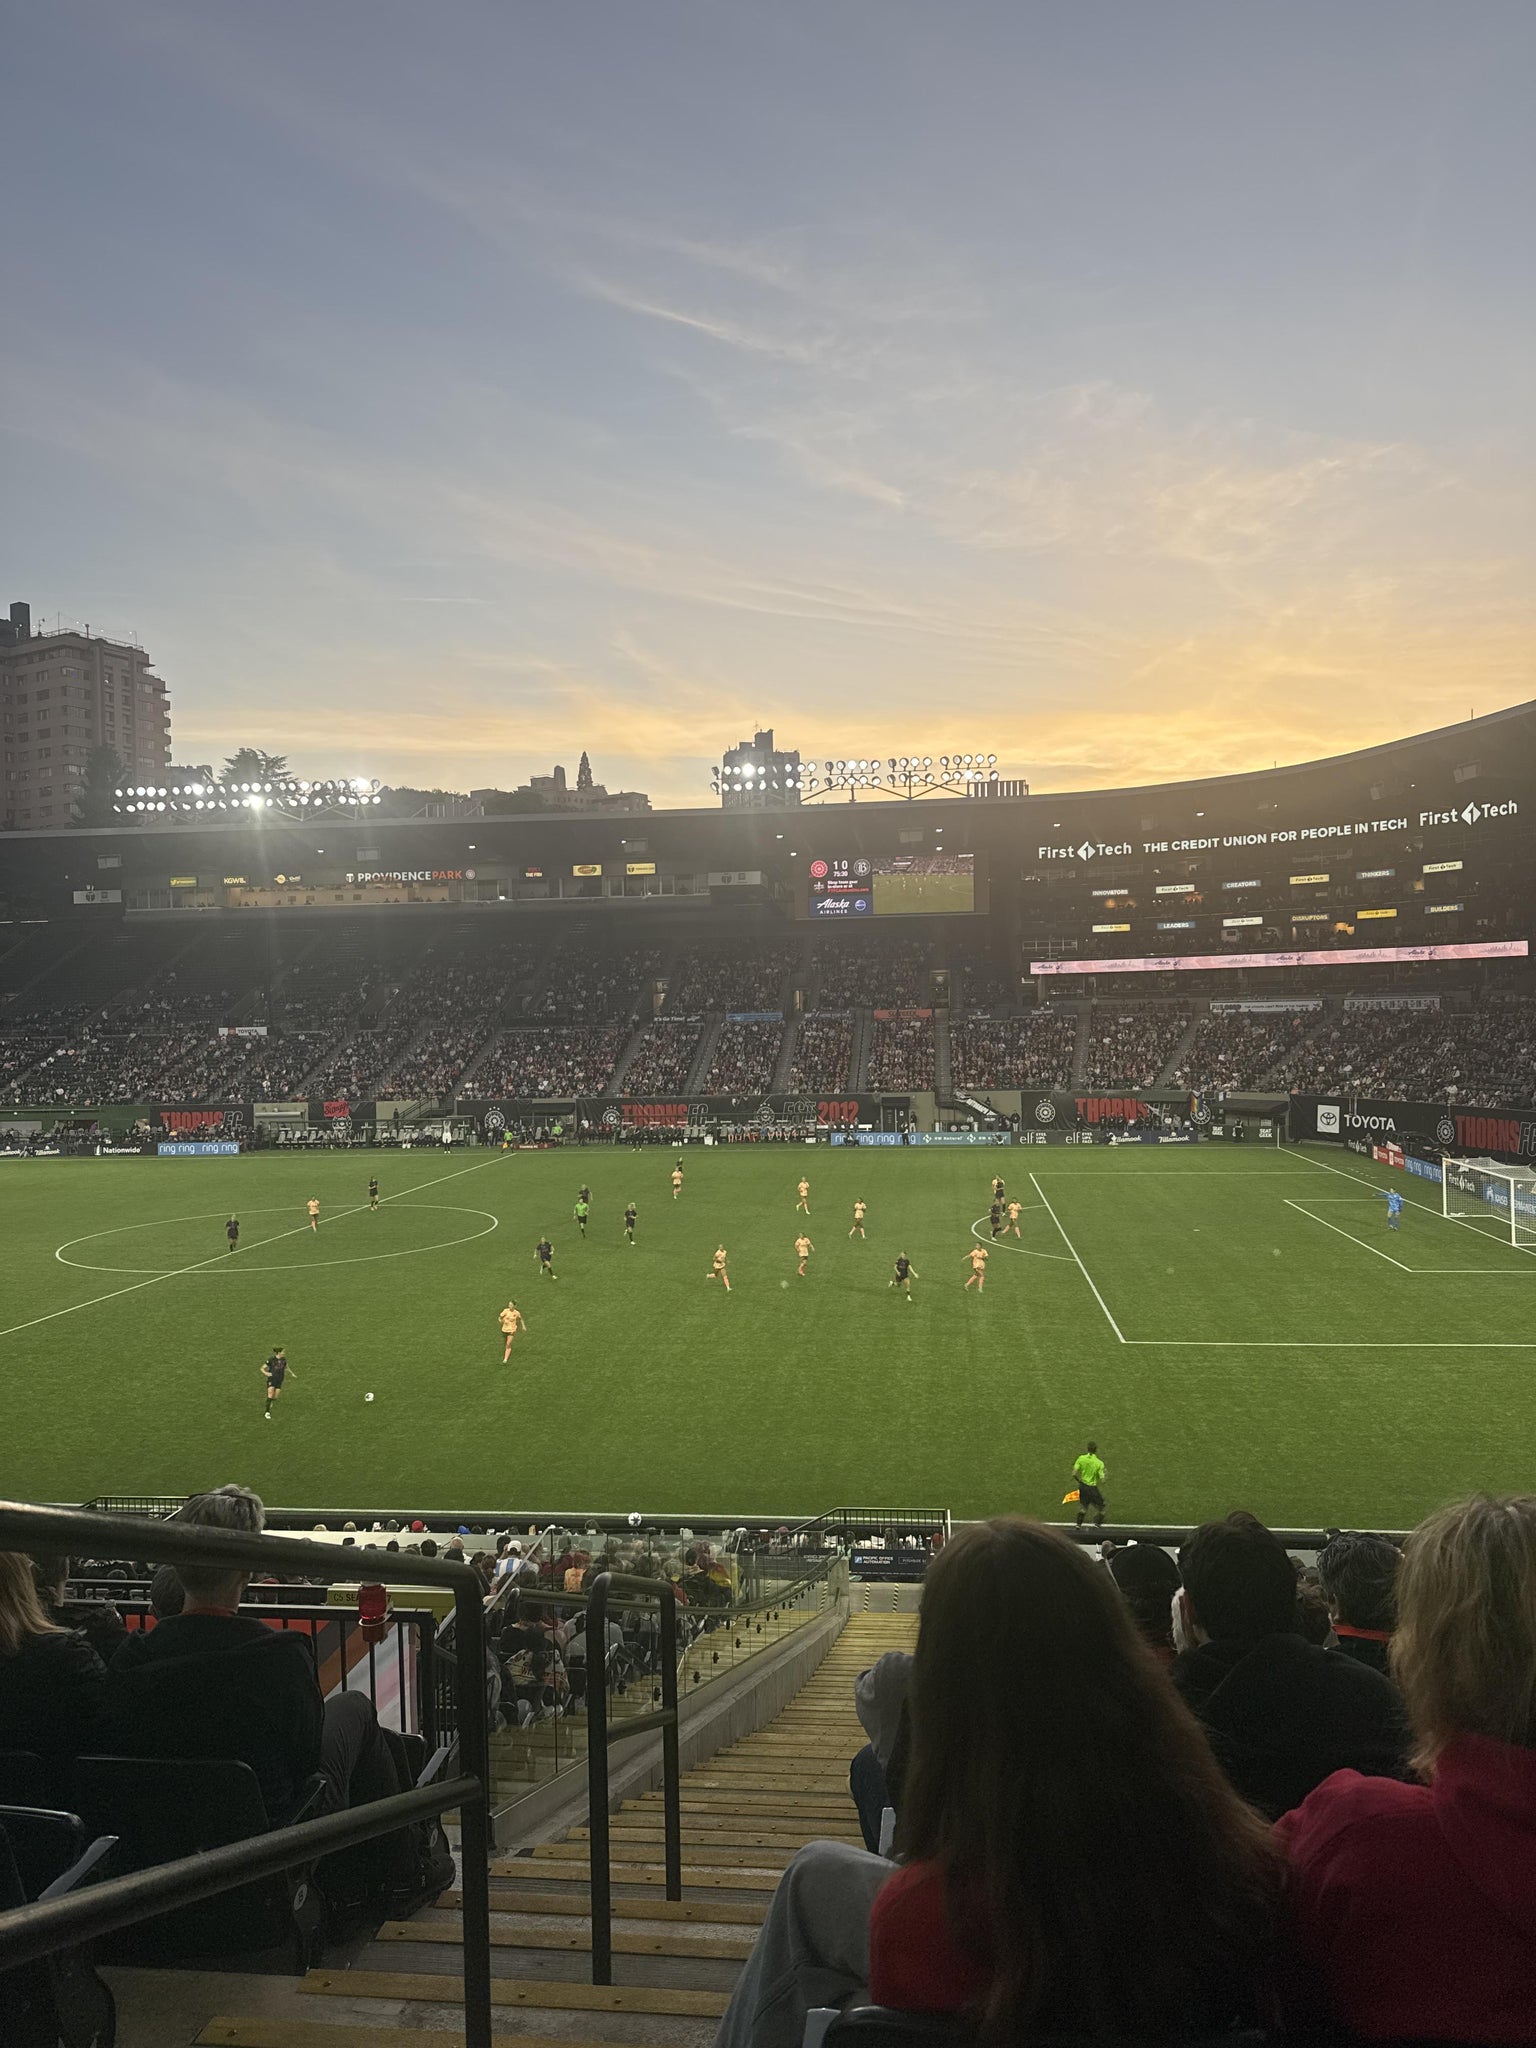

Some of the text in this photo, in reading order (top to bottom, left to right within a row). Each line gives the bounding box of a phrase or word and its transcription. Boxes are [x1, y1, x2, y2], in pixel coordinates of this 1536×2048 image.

[1420, 800, 1517, 826] First Tech
[1143, 818, 1407, 853] THE CREDIT UNION FOR PEOPLE IN TECH
[1038, 842, 1132, 859] First Tech
[1226, 880, 1257, 888] CREATORS
[817, 898, 850, 909] Alaska
[621, 1104, 688, 1126] THORNS
[817, 1101, 859, 1125] 2012
[1075, 1098, 1149, 1122] THORNS
[160, 1110, 244, 1128] THORNS FC
[1344, 1114, 1396, 1131] TOYOTA
[877, 1134, 895, 1144] ring
[1020, 1132, 1034, 1144] elf
[1066, 1132, 1080, 1144] elf
[1456, 1115, 1519, 1152] THORNS
[103, 1146, 140, 1154] Nationwide
[160, 1143, 238, 1154] ring ring ring ring
